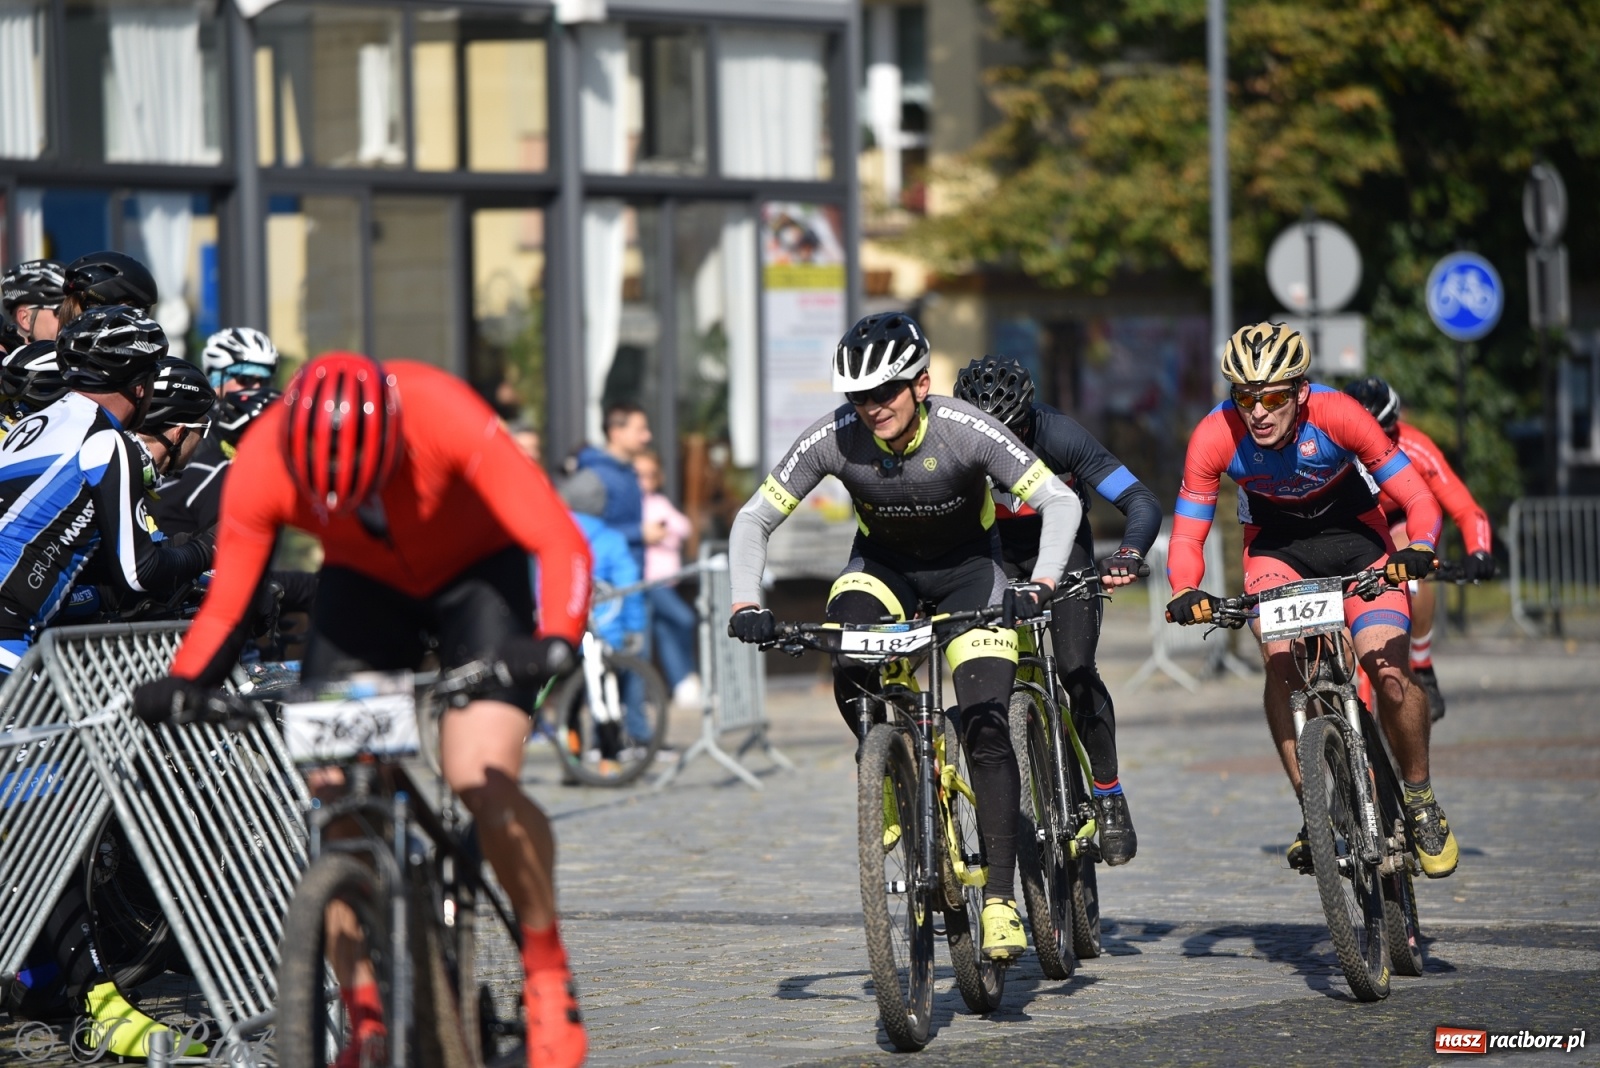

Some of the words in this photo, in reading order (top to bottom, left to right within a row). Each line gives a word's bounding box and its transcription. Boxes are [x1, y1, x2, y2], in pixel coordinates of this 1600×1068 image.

[181, 384, 200, 393] GIRO
[936, 405, 1031, 466] garbaruk
[779, 411, 858, 484] garbaruk
[878, 505, 912, 513] PEVA
[915, 496, 964, 512] POLSKA
[1273, 600, 1328, 624] 1167
[860, 634, 918, 653] 1187
